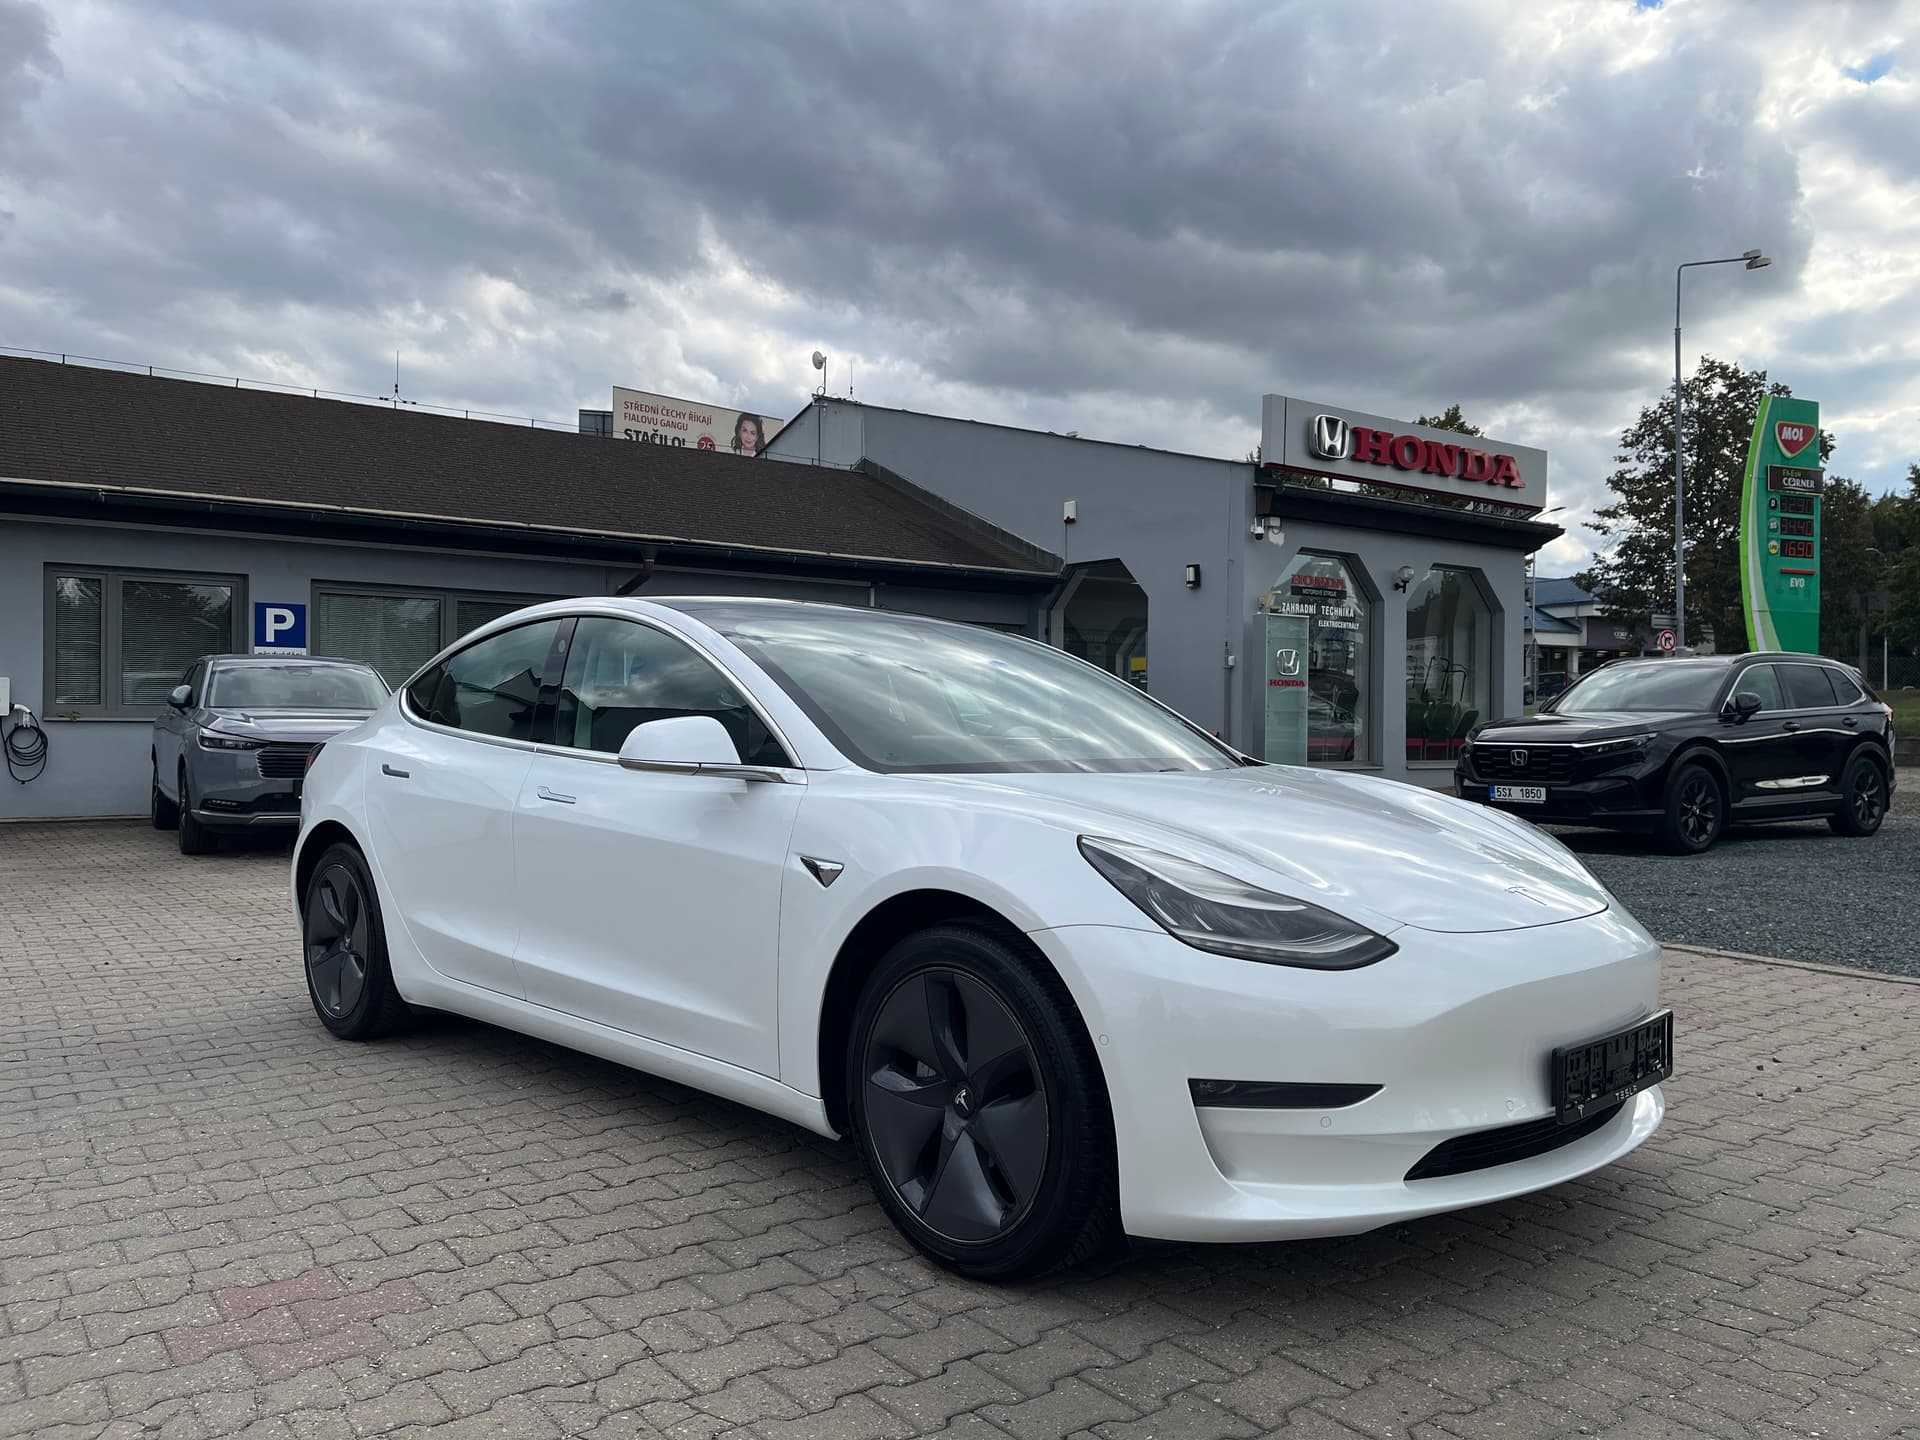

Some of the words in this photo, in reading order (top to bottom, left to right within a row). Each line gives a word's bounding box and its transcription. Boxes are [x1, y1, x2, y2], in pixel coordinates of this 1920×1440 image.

[623, 400, 659, 415] STŘEDNÍ
[661, 406, 687, 420] ČECHY
[688, 410, 712, 426] ŘÍKAJÍ
[624, 412, 658, 426] FIALOVU
[660, 418, 688, 432] GANGU
[1781, 426, 1804, 441] MOL
[1351, 426, 1526, 489] HONDA
[1782, 477, 1815, 488] CORNER
[1790, 577, 1805, 588] EVO
[1281, 602, 1317, 615] ZAHRADNÍ
[1321, 605, 1354, 618] TECHNIKA
[266, 607, 295, 642] P
[1269, 679, 1306, 688] HONDA
[1496, 787, 1512, 798] 5SX
[1519, 788, 1542, 799] 1850
[1615, 1085, 1638, 1101] TESLA
